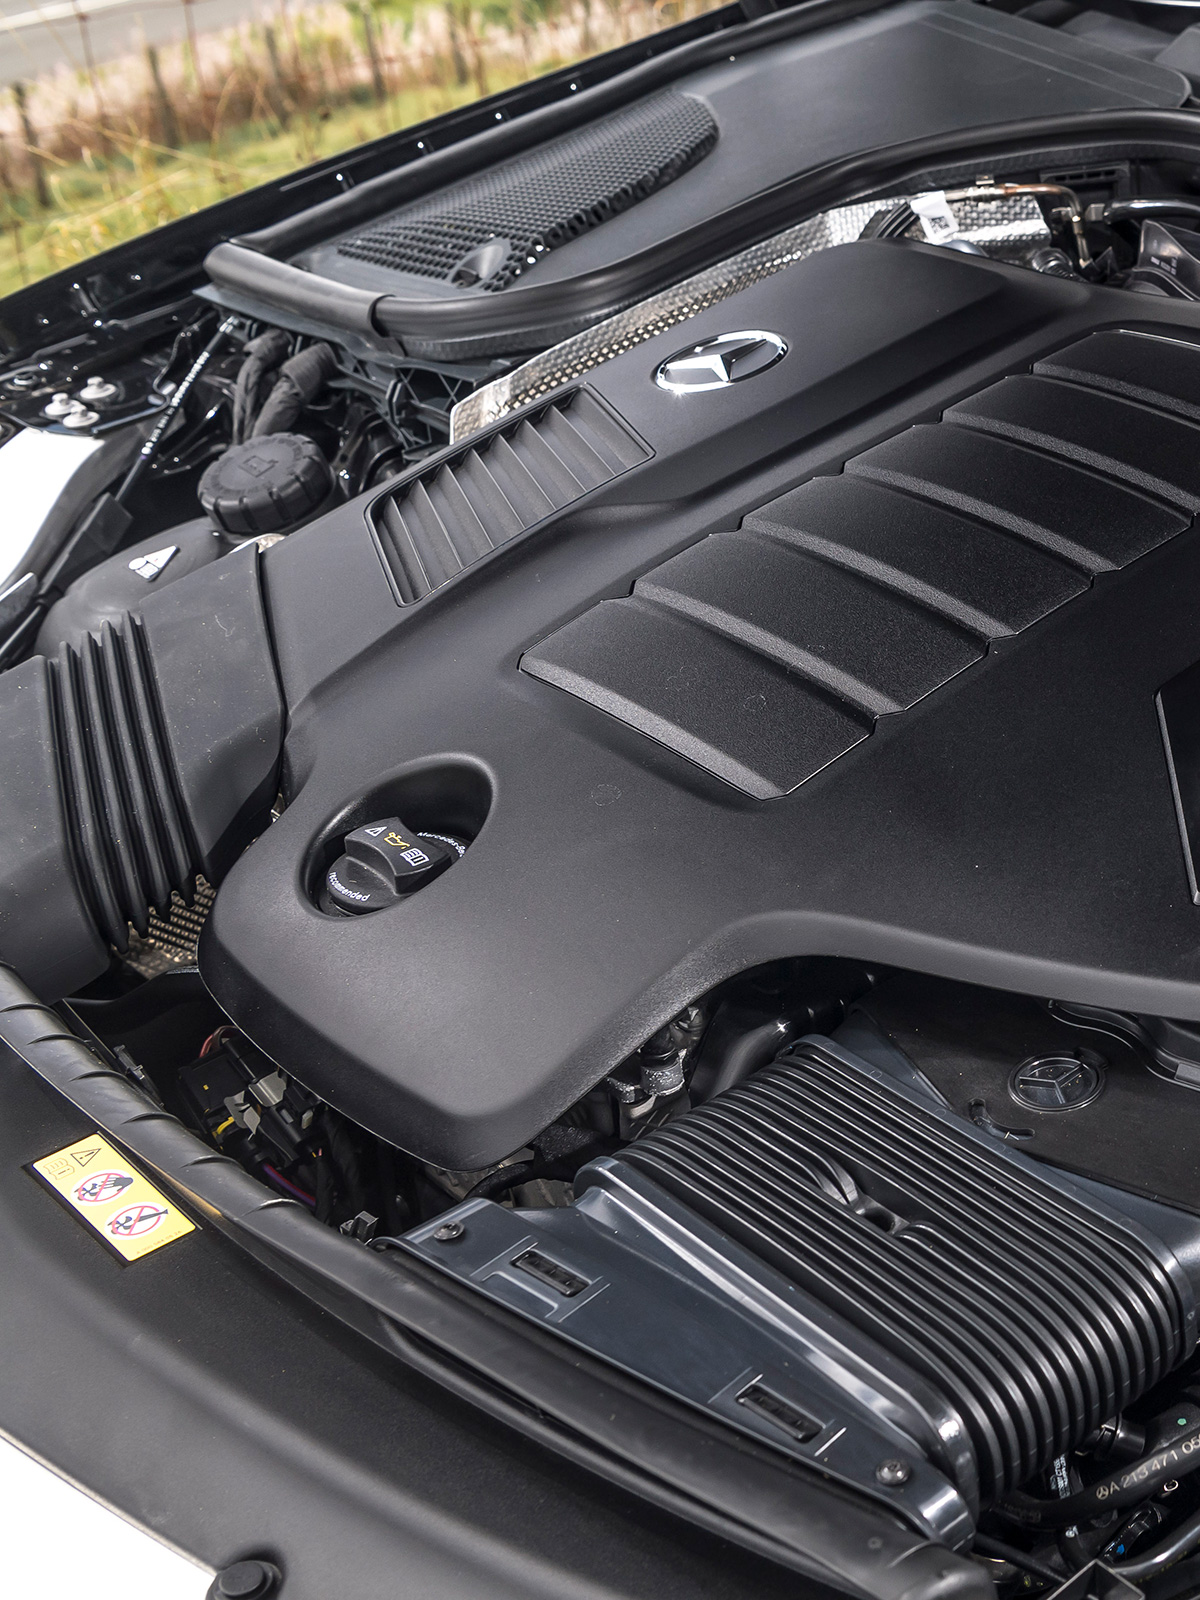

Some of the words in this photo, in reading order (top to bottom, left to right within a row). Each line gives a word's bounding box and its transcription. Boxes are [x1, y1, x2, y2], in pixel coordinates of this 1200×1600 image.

[328, 871, 371, 902] recommended
[1121, 1467, 1150, 1489] 213
[1151, 1449, 1179, 1472] 471
